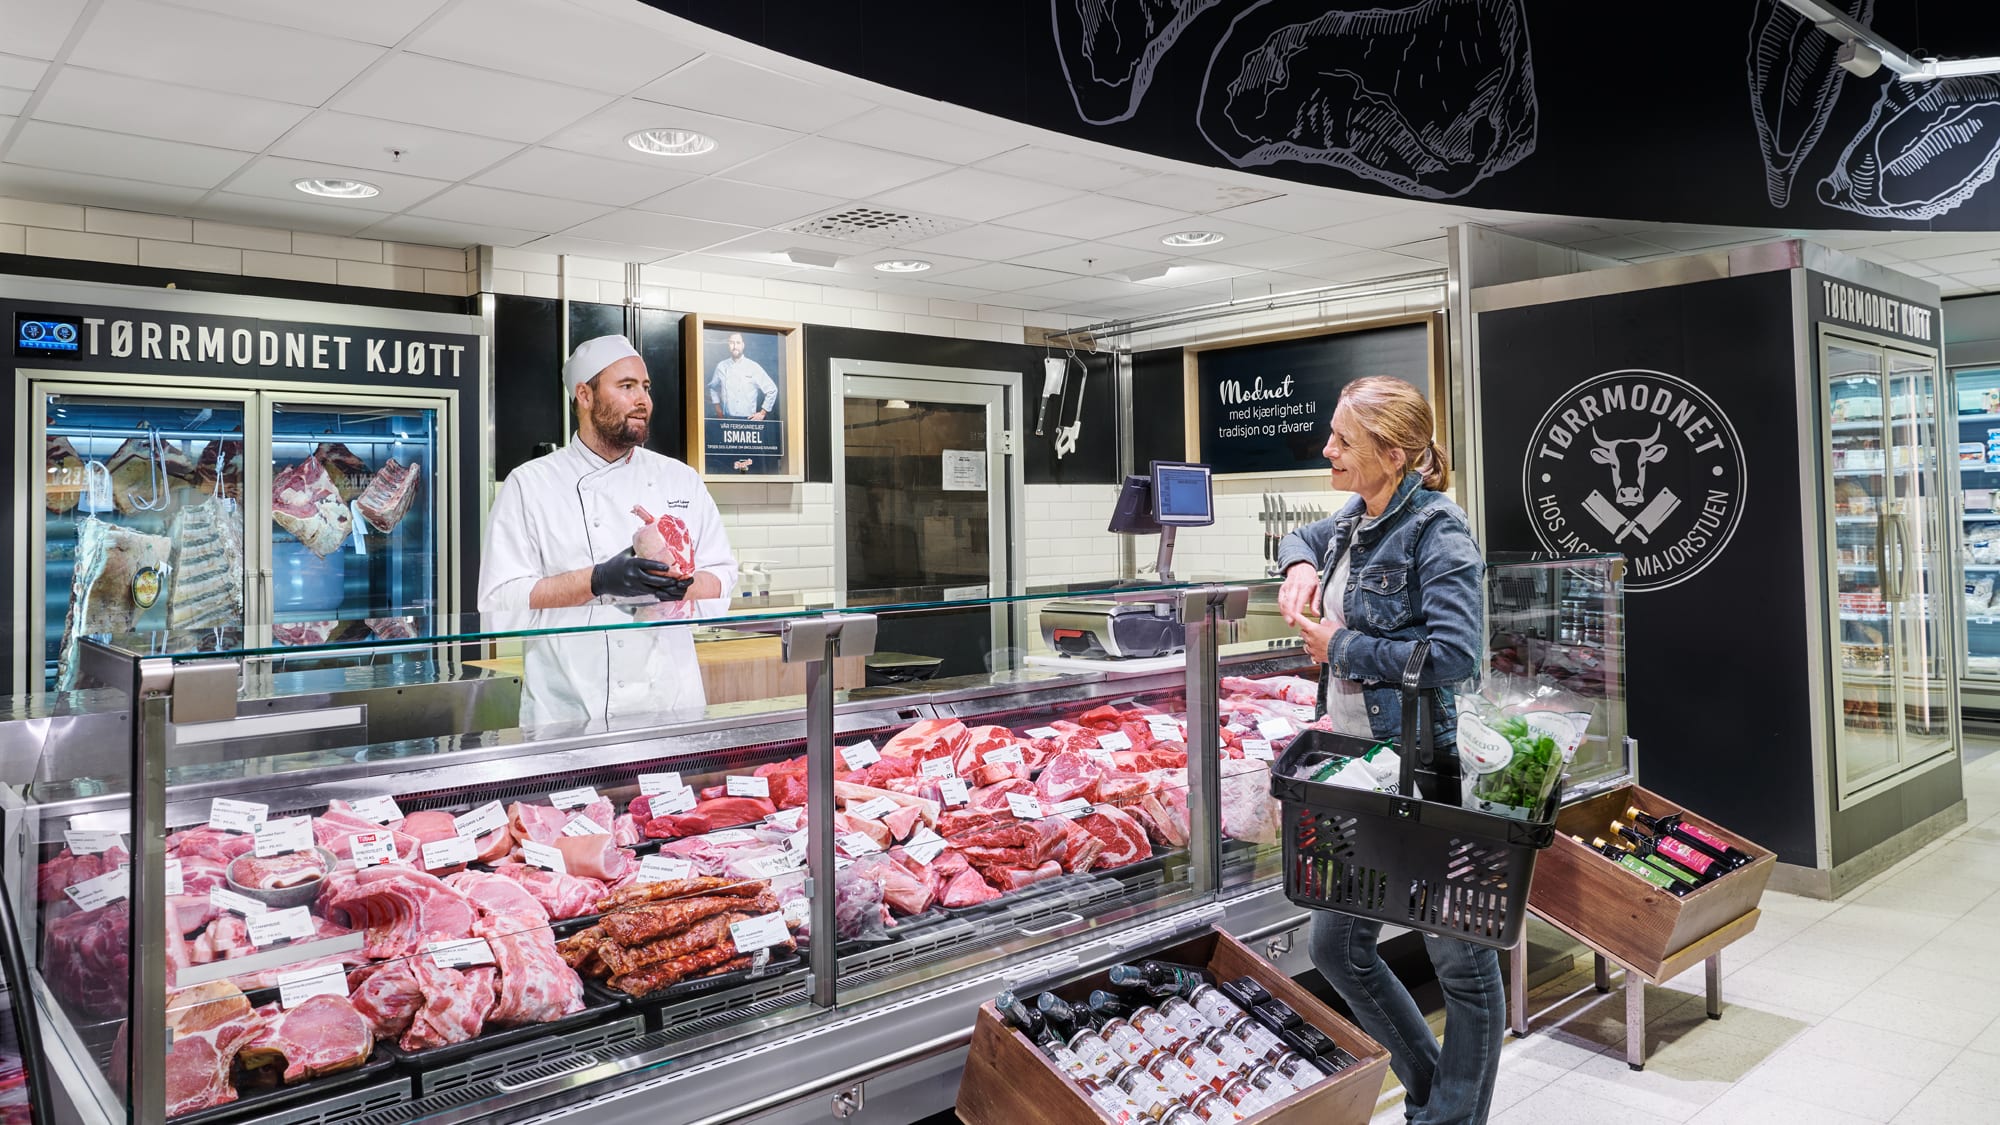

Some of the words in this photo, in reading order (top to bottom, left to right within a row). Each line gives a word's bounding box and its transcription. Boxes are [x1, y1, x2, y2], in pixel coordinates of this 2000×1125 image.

[1822, 281, 1899, 332] TØRRMODNET
[82, 317, 352, 371] TØRRMODNET
[366, 338, 466, 378] KJØTT
[1219, 374, 1295, 405] Modnet
[1219, 424, 1260, 438] tradisjon
[1262, 425, 1275, 437] og
[1278, 420, 1314, 434] råvarer
[1229, 407, 1251, 421] med
[1253, 403, 1303, 420] kjærlighet
[1305, 401, 1316, 414] til
[1539, 384, 1725, 461] TØRRMODNET
[724, 430, 763, 443] ISMAREL
[1538, 494, 1566, 532] HOS
[1634, 489, 1729, 577] MAJORSTUEN
